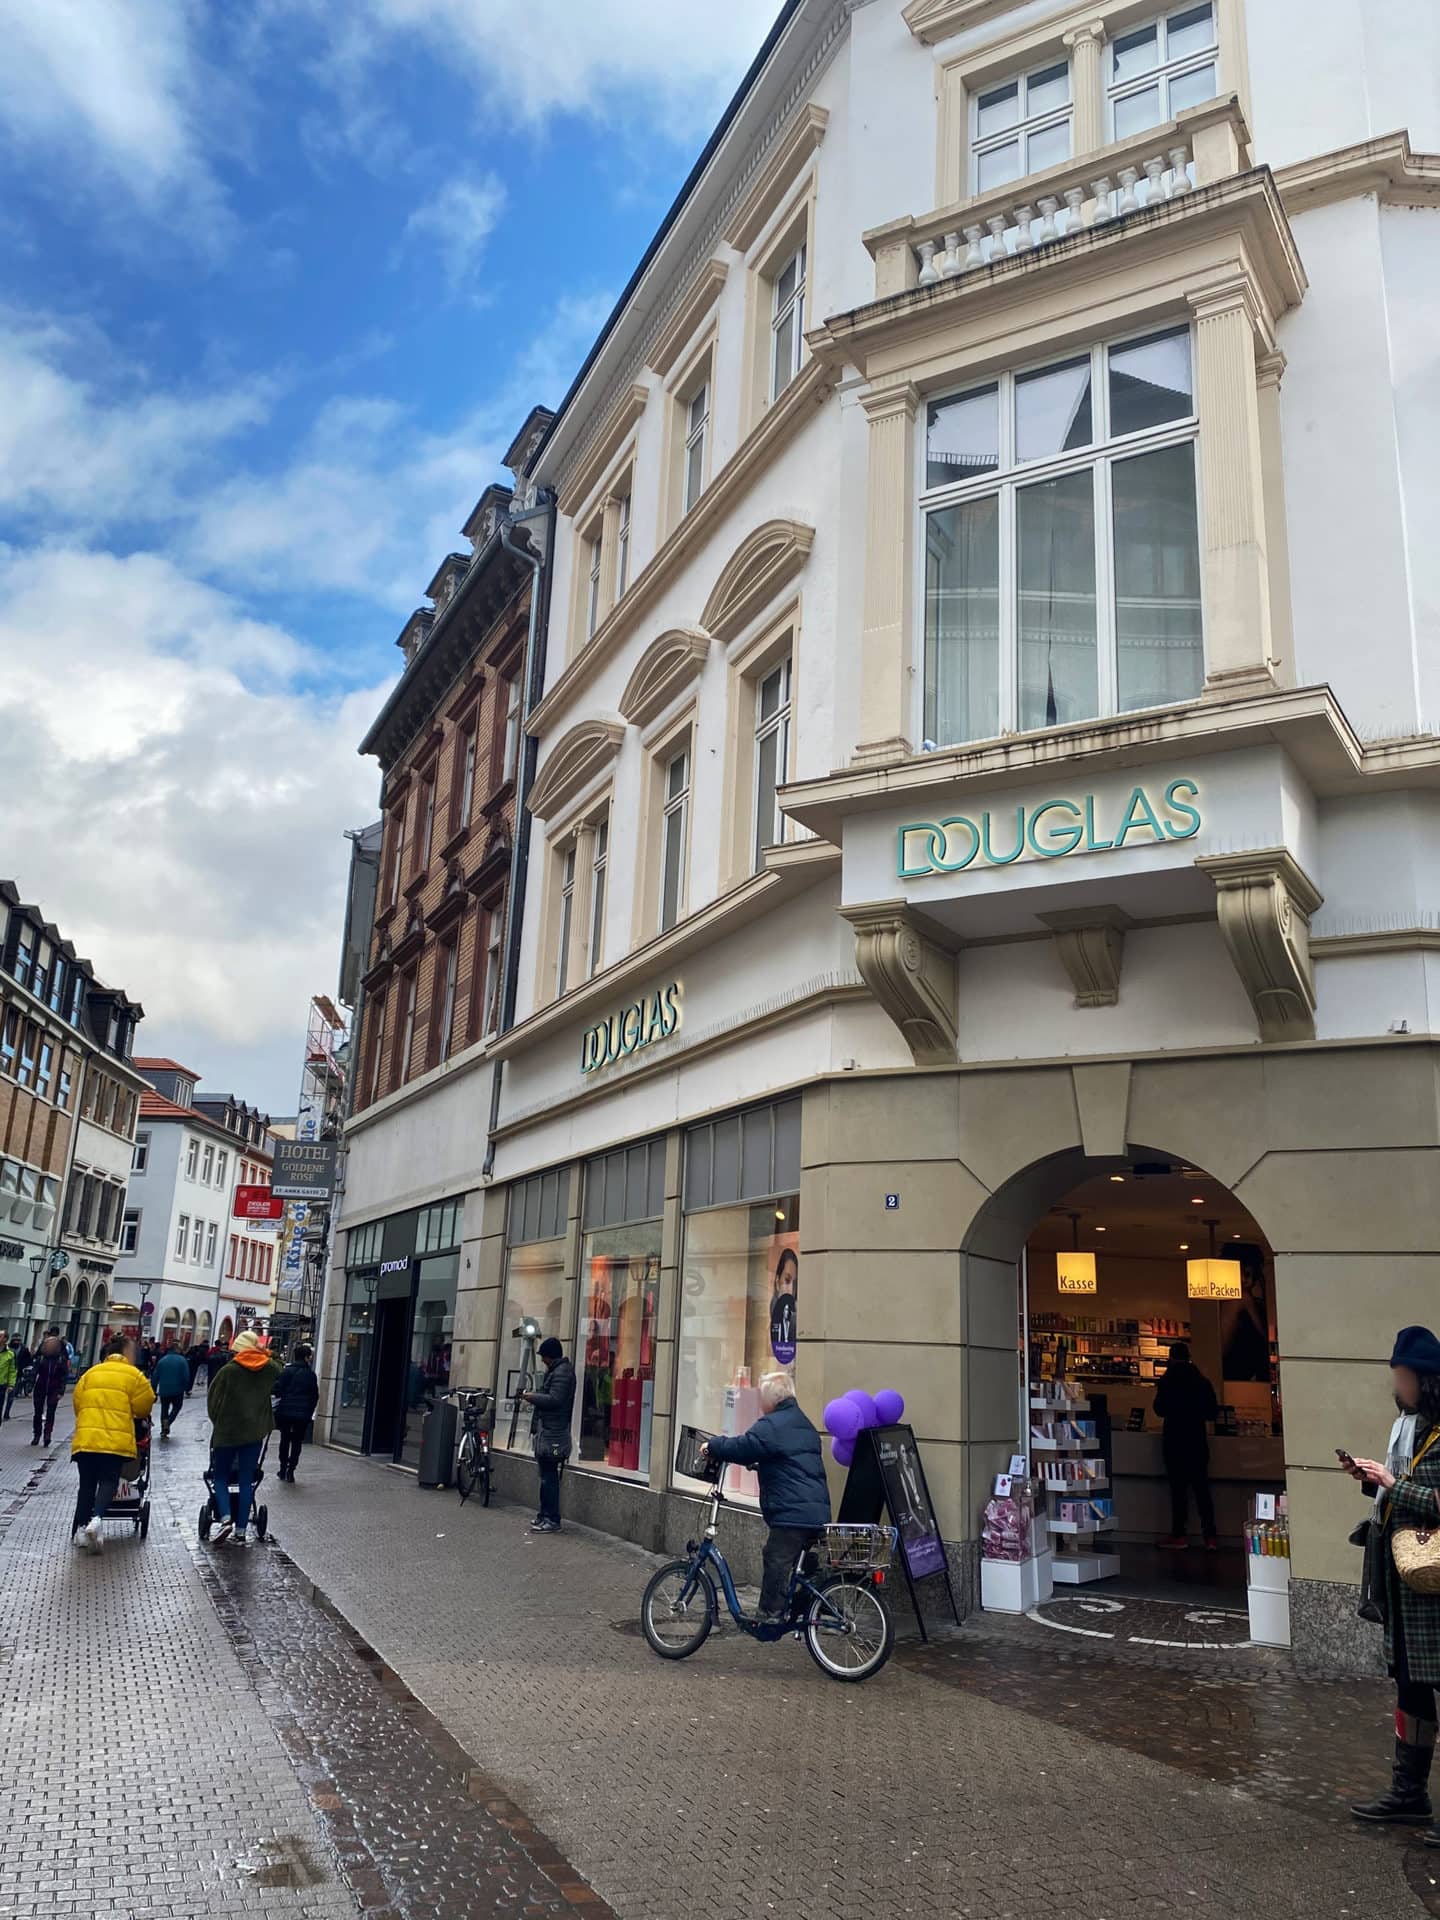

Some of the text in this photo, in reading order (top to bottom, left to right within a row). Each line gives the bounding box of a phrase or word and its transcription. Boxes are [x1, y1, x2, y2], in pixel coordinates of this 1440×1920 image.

[897, 779, 1200, 878] DOUGLAS
[581, 983, 679, 1074] DOUGLAS
[280, 1145, 330, 1160] HOTEL
[281, 1162, 325, 1173] GOLDENE
[290, 1172, 314, 1182] ROSE
[286, 1203, 308, 1270] King of
[380, 1256, 408, 1277] promod
[1060, 1275, 1094, 1290] Kasse
[1189, 1283, 1208, 1297] Packen
[1210, 1282, 1240, 1298] Packen
